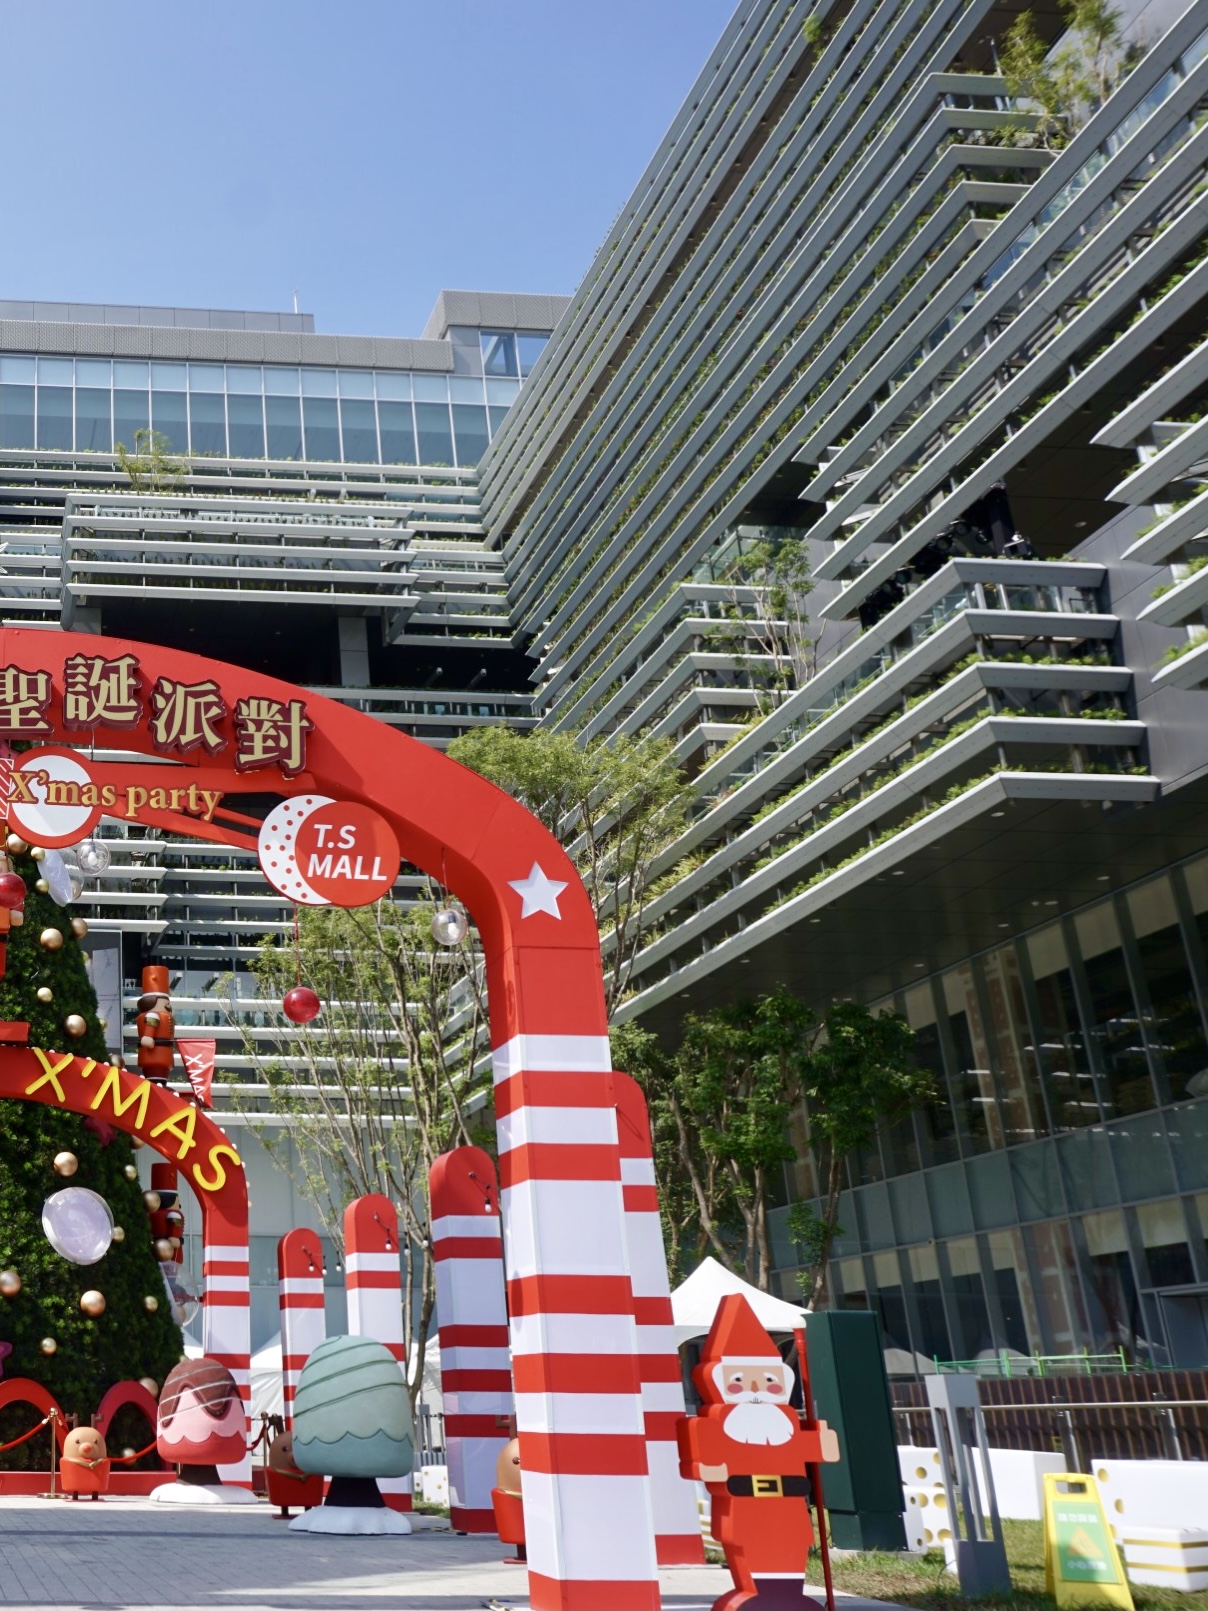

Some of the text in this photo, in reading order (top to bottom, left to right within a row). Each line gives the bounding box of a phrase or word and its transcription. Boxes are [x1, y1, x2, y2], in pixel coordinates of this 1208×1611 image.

[6, 769, 117, 806] X'mas
[125, 783, 223, 822] party
[313, 823, 357, 849] T.S
[307, 853, 388, 881] MALL
[24, 1046, 241, 1192] X'MAS
